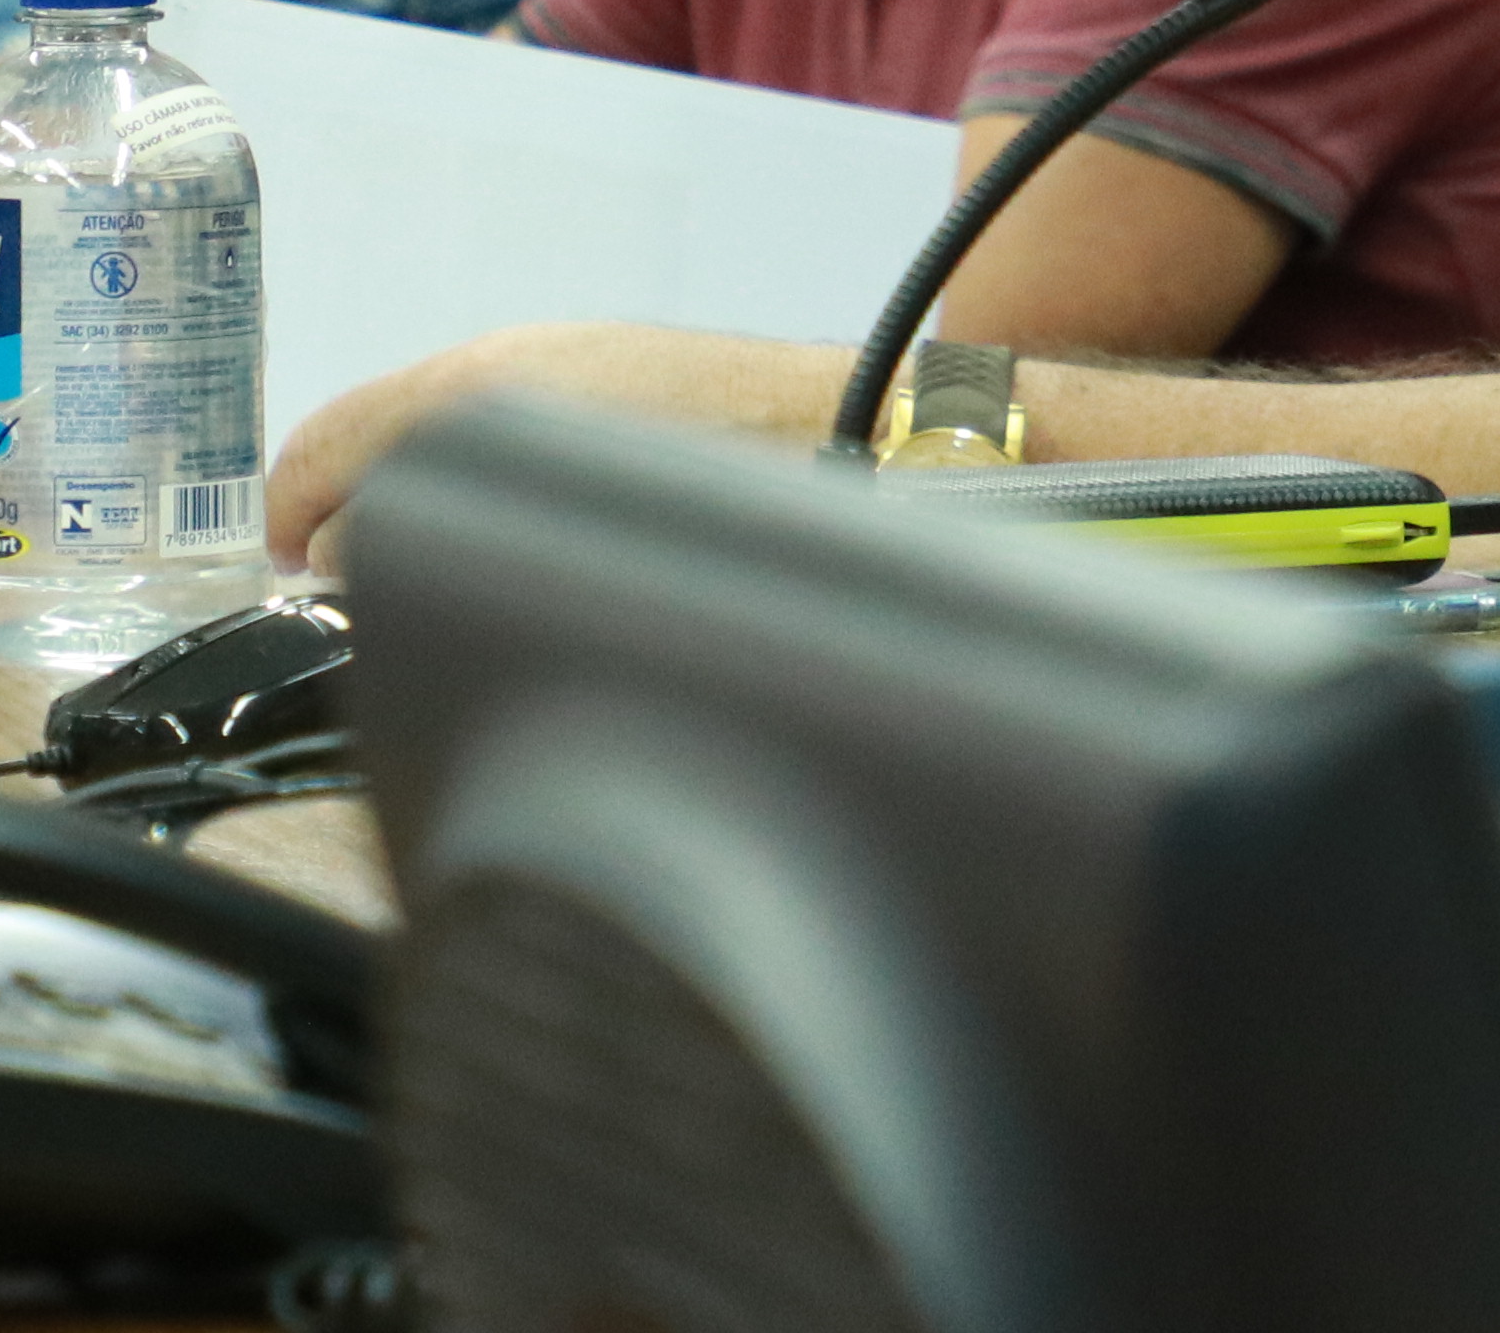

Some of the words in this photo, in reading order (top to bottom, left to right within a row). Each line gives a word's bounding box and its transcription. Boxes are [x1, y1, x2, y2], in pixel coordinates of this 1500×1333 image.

[115, 120, 144, 139] USO
[144, 100, 191, 126] CÂMARA
[130, 132, 163, 156] Favor
[165, 123, 186, 139] não
[82, 211, 144, 234] ATENÇÃO
[61, 324, 83, 337] SAC
[86, 324, 110, 339] (34)
[165, 534, 173, 548] 7
[179, 529, 226, 547] 897534
